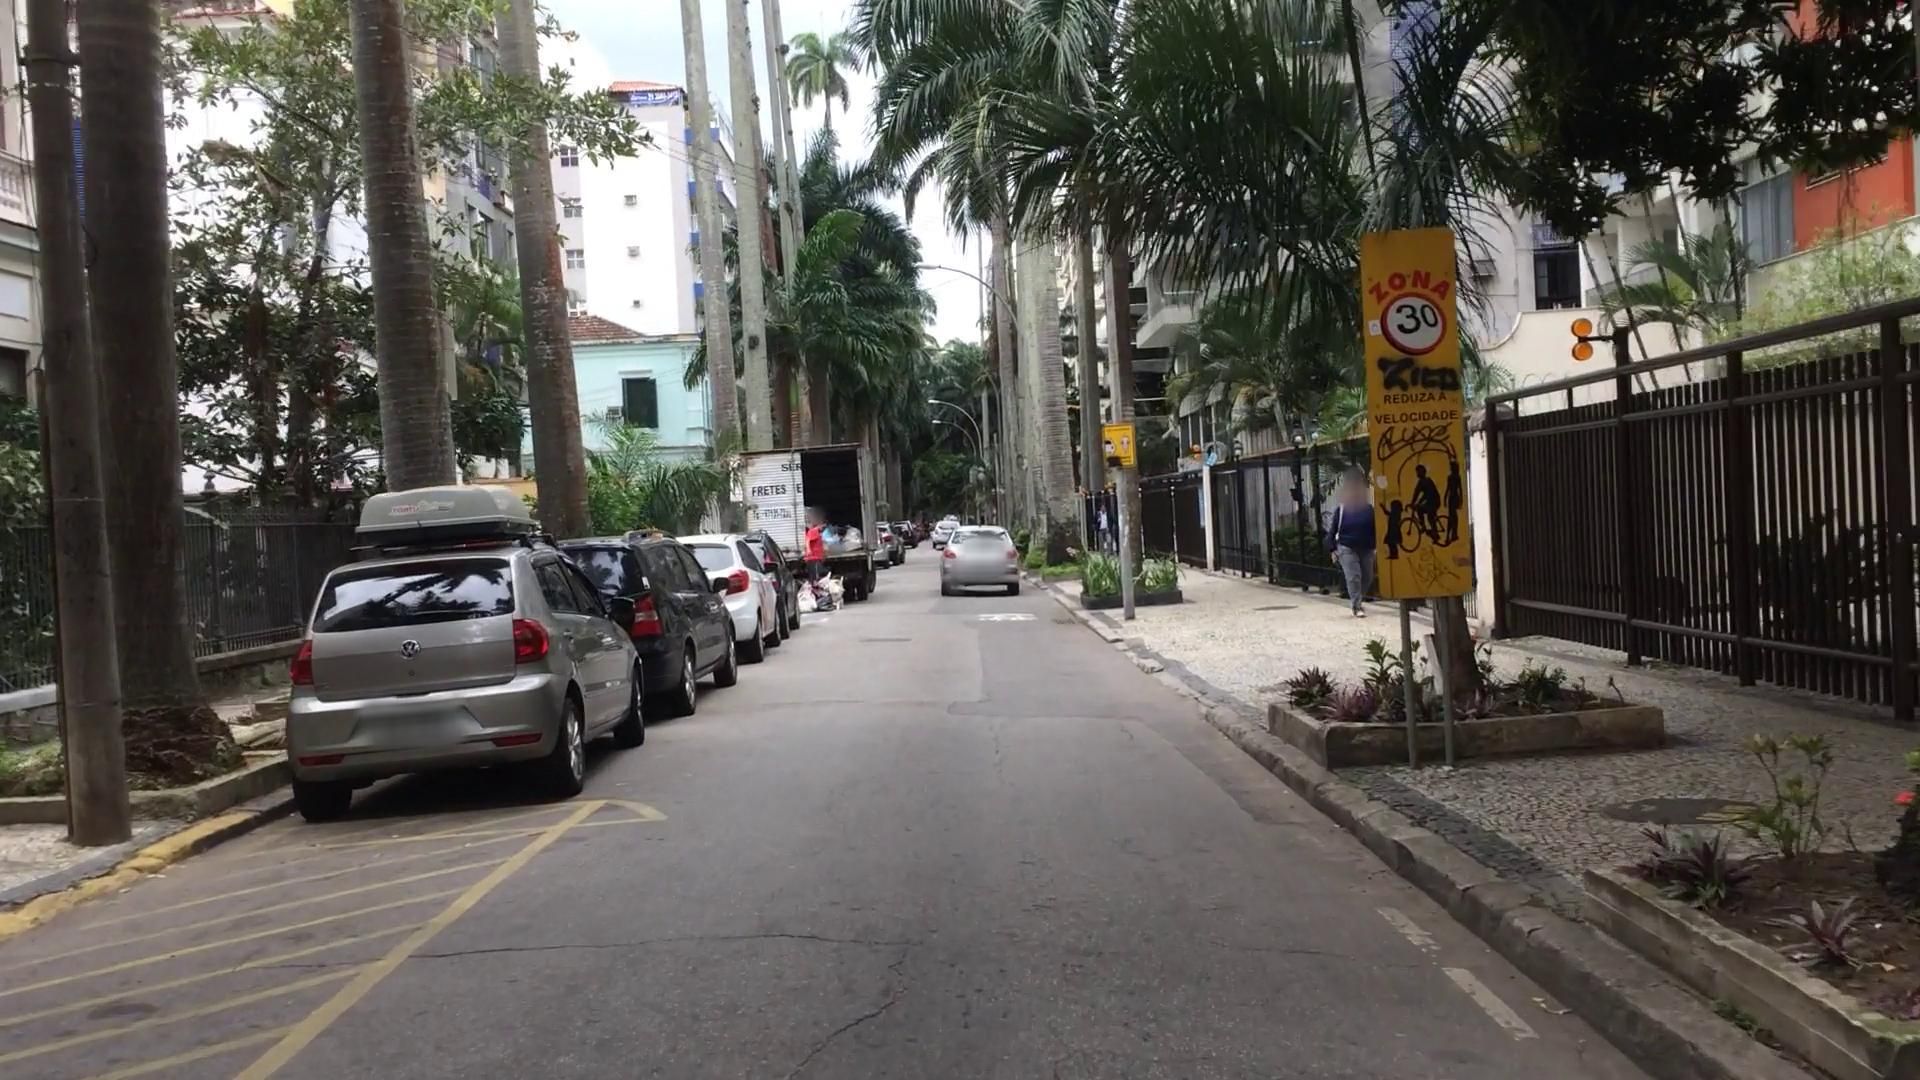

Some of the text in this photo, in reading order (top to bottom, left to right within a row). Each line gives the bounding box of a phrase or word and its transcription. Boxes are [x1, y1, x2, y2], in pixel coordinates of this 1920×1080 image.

[1369, 270, 1450, 304] ZONA
[1395, 304, 1438, 334] 30
[1383, 392, 1436, 405] REDUZA
[1375, 410, 1459, 424] VELOCIDADE
[752, 484, 786, 497] FRETES
